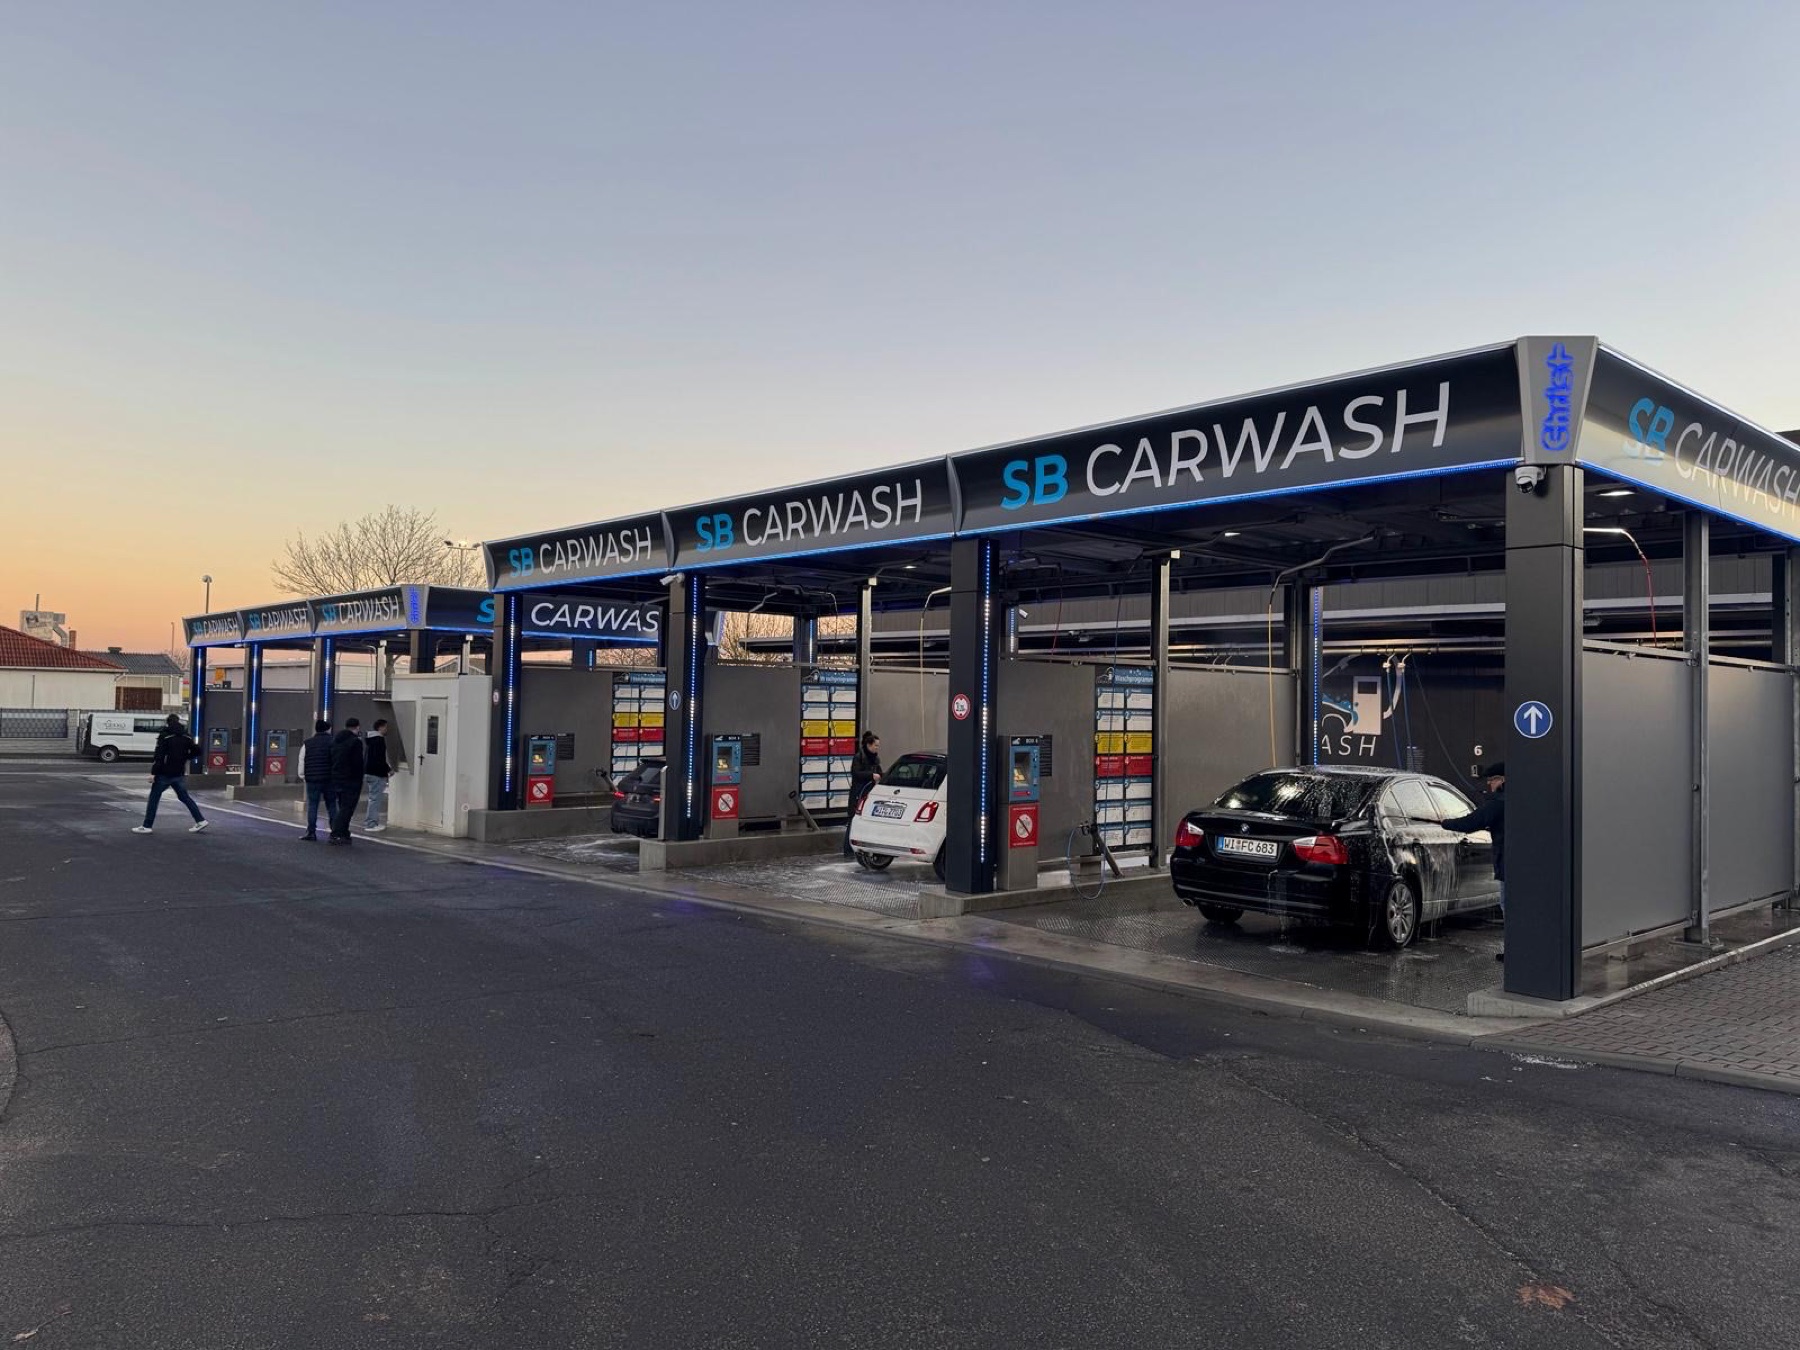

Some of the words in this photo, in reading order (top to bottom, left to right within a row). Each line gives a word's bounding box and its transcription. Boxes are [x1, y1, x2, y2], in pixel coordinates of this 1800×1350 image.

[999, 453, 1069, 511] SB
[1086, 381, 1451, 497] CARWASH
[1622, 397, 1675, 466] SB
[1674, 422, 1800, 521] CARWASH
[695, 513, 735, 553] SB
[742, 479, 922, 547] CARWASH
[508, 547, 535, 578] SB
[539, 526, 652, 574] CARWASH
[249, 613, 261, 631] SB
[261, 607, 308, 632] CARWASH
[321, 603, 337, 626] SB
[339, 595, 400, 623] CARWASH
[476, 597, 495, 623] S
[531, 602, 660, 633] CARWAS
[203, 617, 240, 638] CARWASH
[1474, 745, 1484, 756] 6
[1224, 838, 1235, 849] WI
[1241, 840, 1254, 852] FC
[1255, 842, 1275, 854] 683
